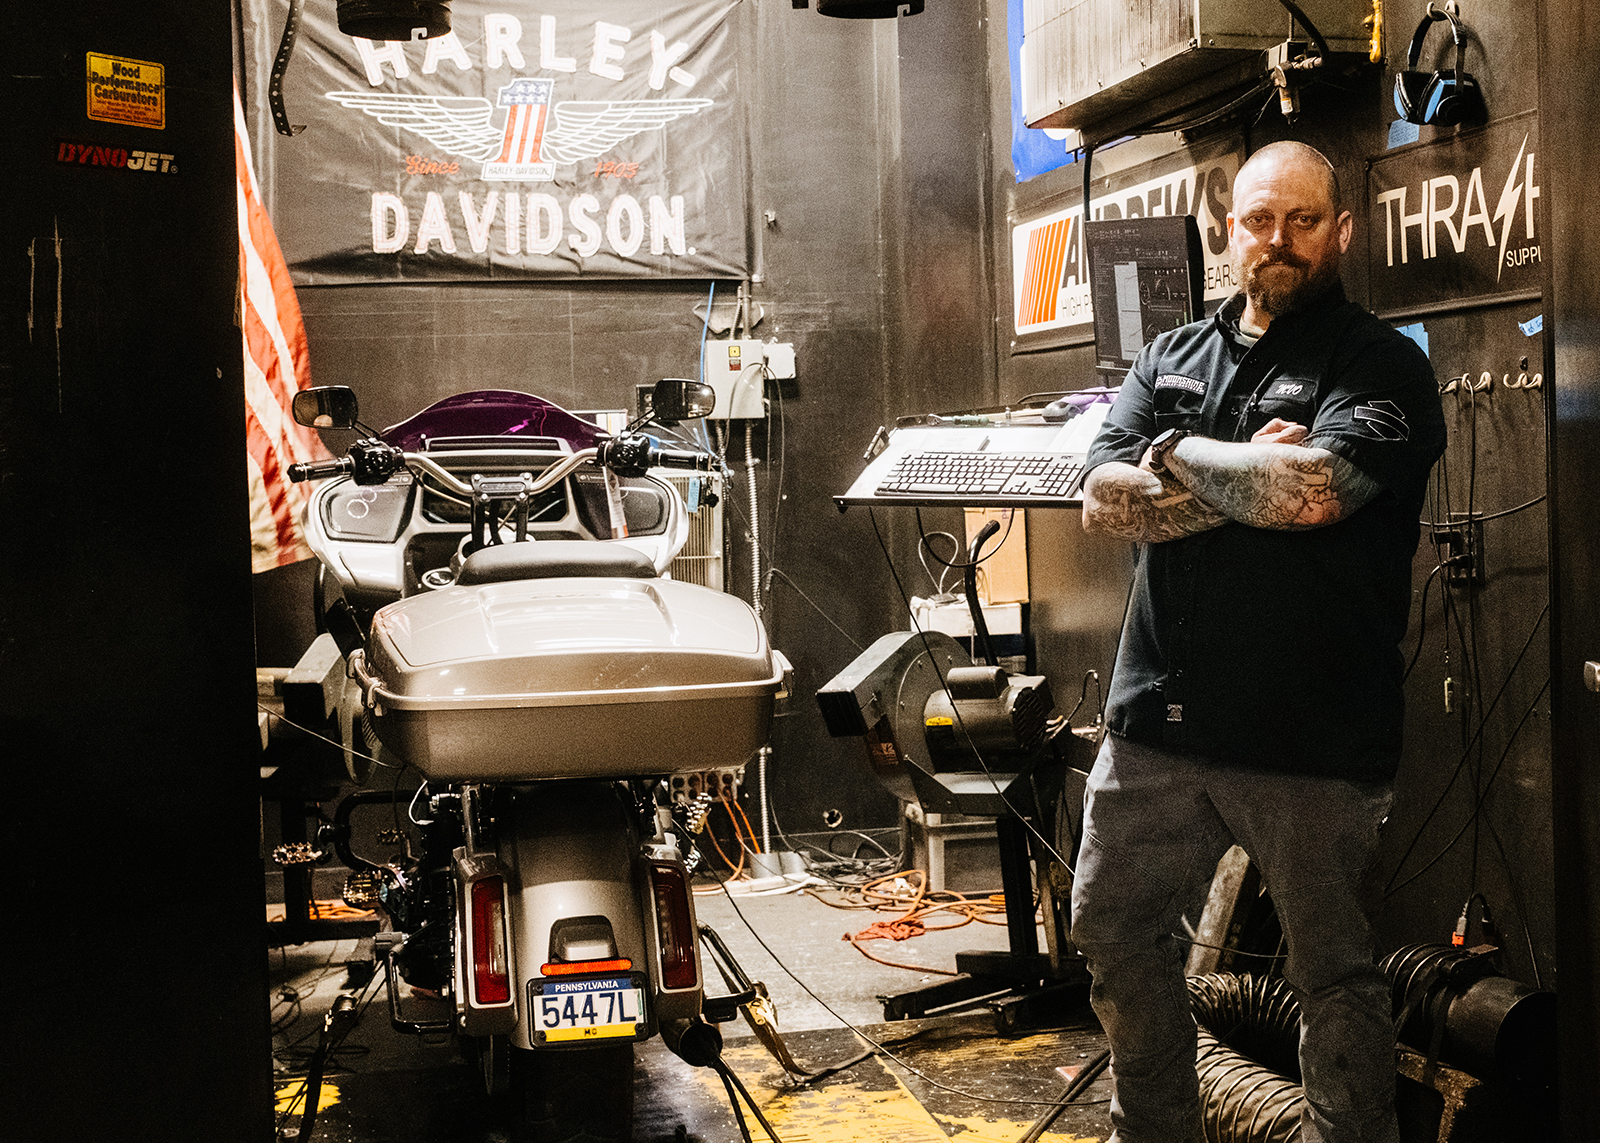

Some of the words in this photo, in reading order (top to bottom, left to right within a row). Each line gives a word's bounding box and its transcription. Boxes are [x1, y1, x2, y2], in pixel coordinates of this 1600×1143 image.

[353, 13, 697, 91] HARLEY
[112, 62, 140, 79] Wood
[92, 71, 160, 94] Performance
[95, 85, 158, 106] Carburetors
[406, 155, 459, 176] Since
[594, 161, 640, 179] 1903
[1061, 296, 1083, 318] HIGH
[555, 980, 619, 992] PENNSYLVANIA
[541, 991, 637, 1028] 5447L
